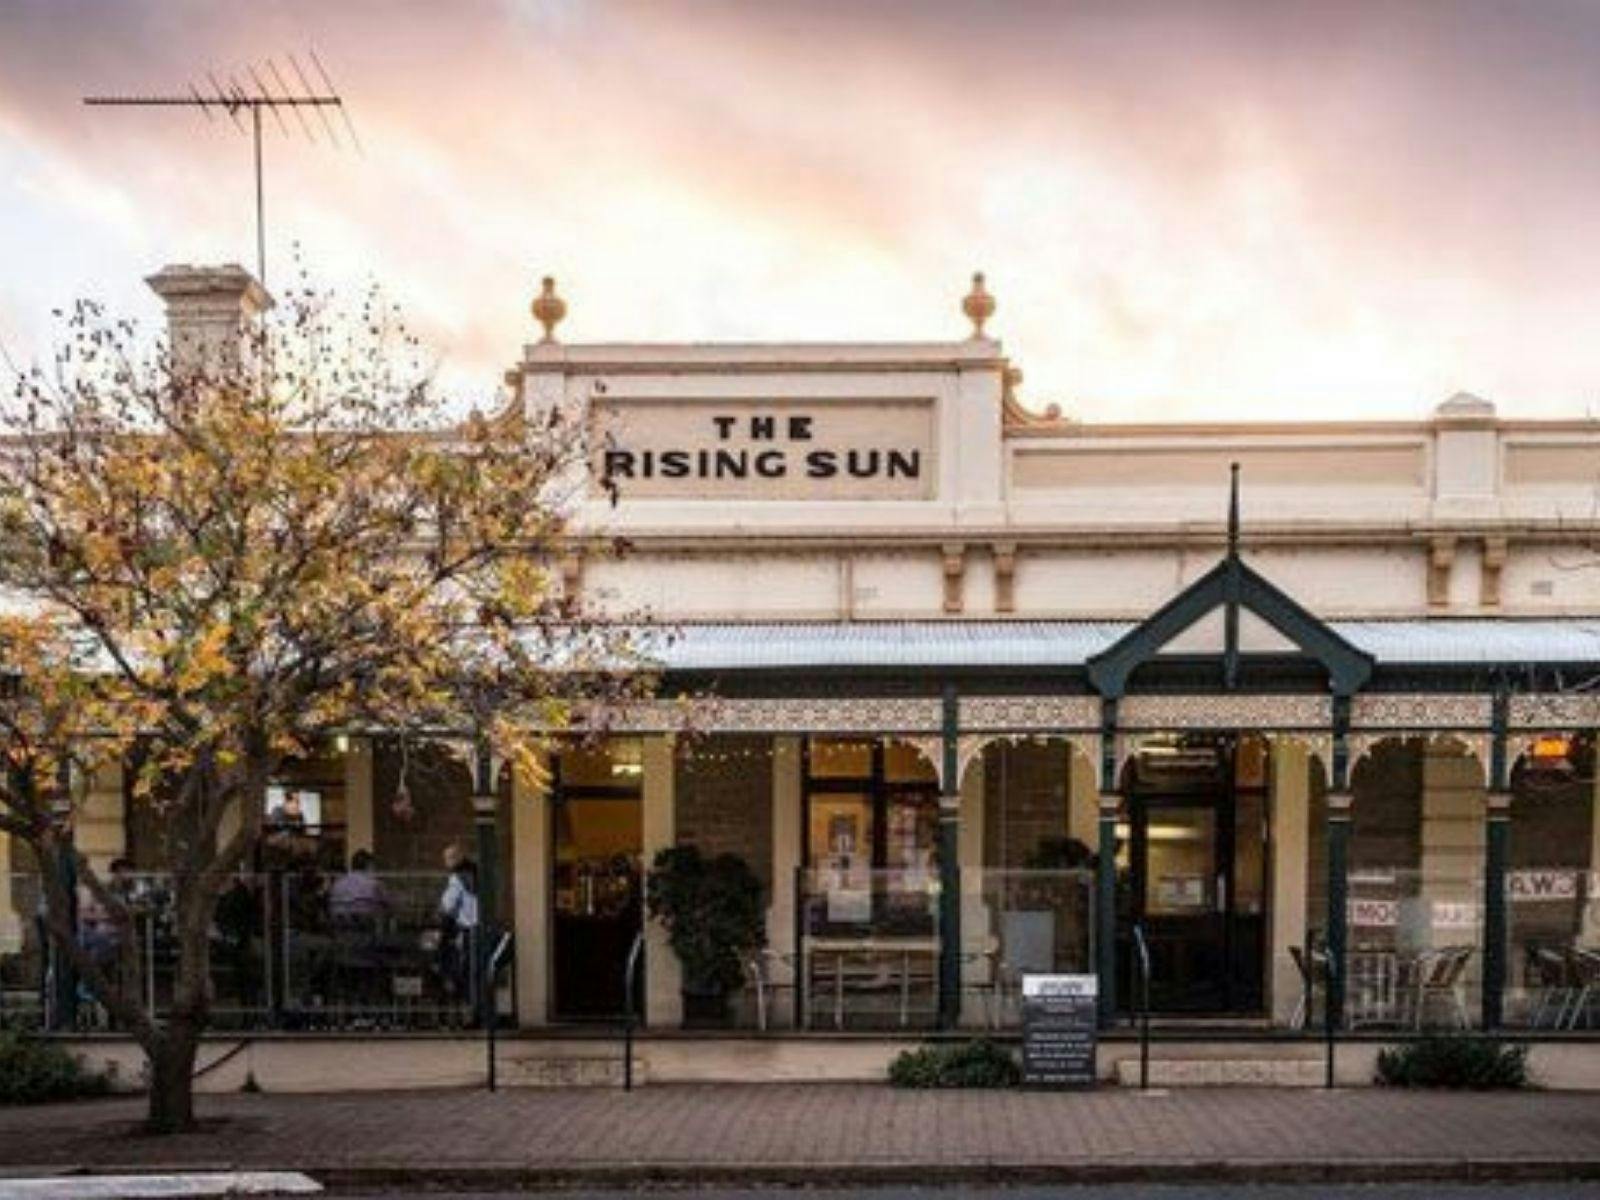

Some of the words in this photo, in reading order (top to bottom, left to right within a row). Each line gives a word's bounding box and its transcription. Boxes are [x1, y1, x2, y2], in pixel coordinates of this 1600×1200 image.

[713, 416, 813, 440] THE
[605, 450, 786, 479] RISING
[806, 450, 919, 479] SUN
